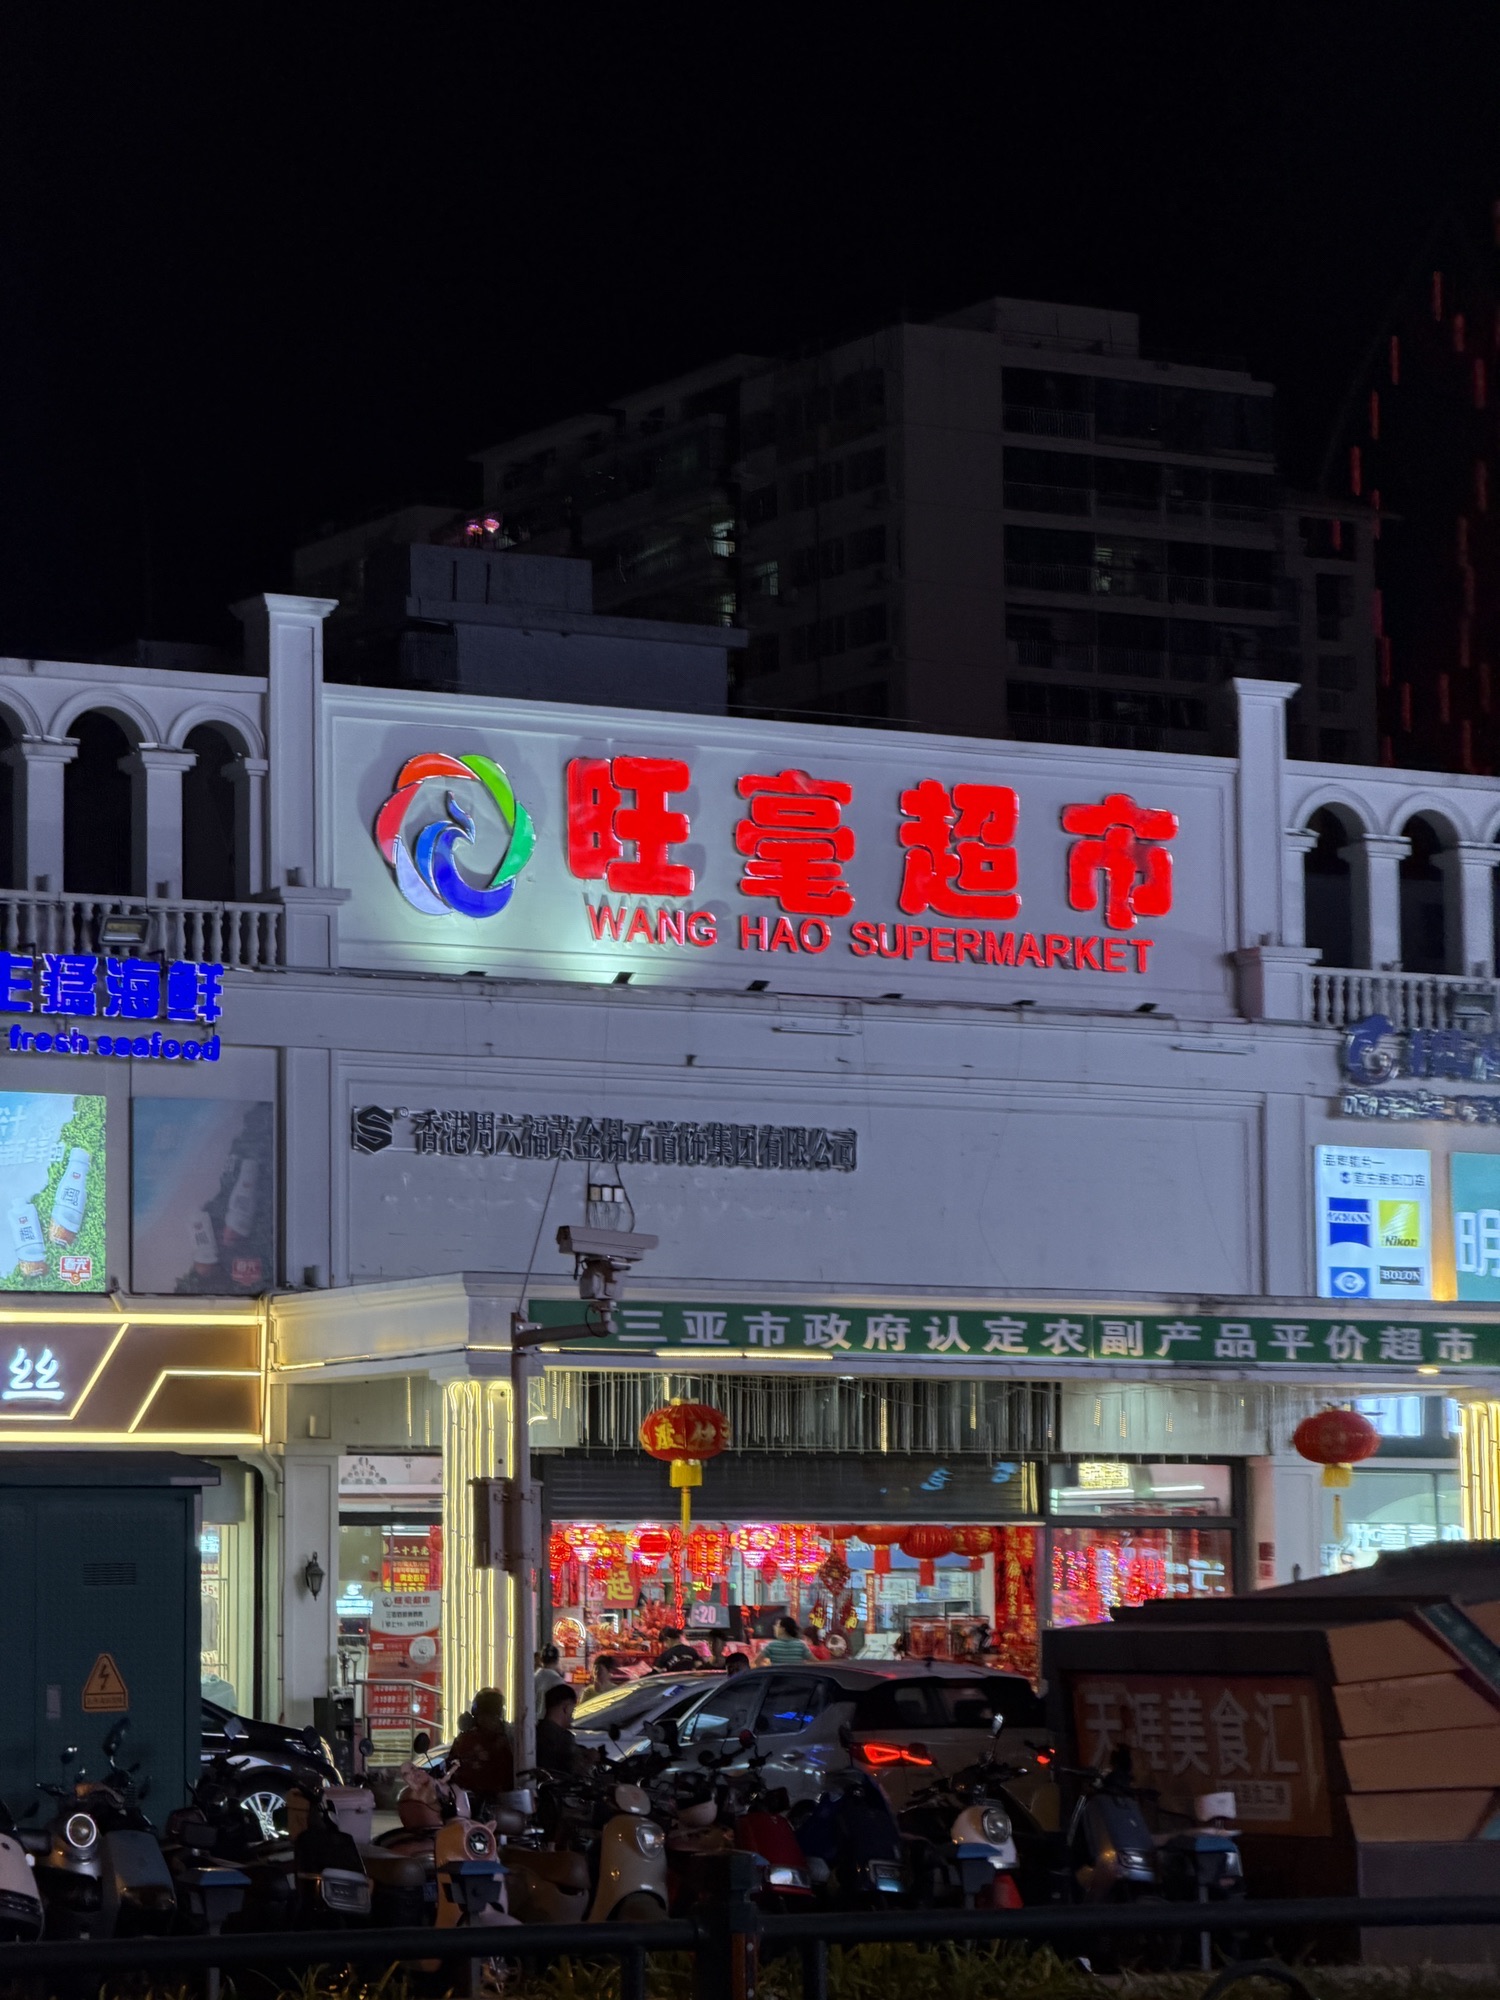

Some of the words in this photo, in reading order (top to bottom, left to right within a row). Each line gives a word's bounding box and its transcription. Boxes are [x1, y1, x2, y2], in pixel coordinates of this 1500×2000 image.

[567, 756, 1179, 930] 旺毫超市
[586, 904, 718, 947] WANG
[740, 914, 832, 954] HAO
[851, 920, 1155, 973] SUPERMARKET
[9, 1024, 90, 1055] fresh
[96, 1031, 221, 1062] seafood
[1384, 1234, 1418, 1248] Nikon
[1380, 1269, 1420, 1281] BOLON
[617, 1308, 1477, 1363] 三亚市政府认定农副产品平价超市
[2, 1347, 66, 1401] 丝
